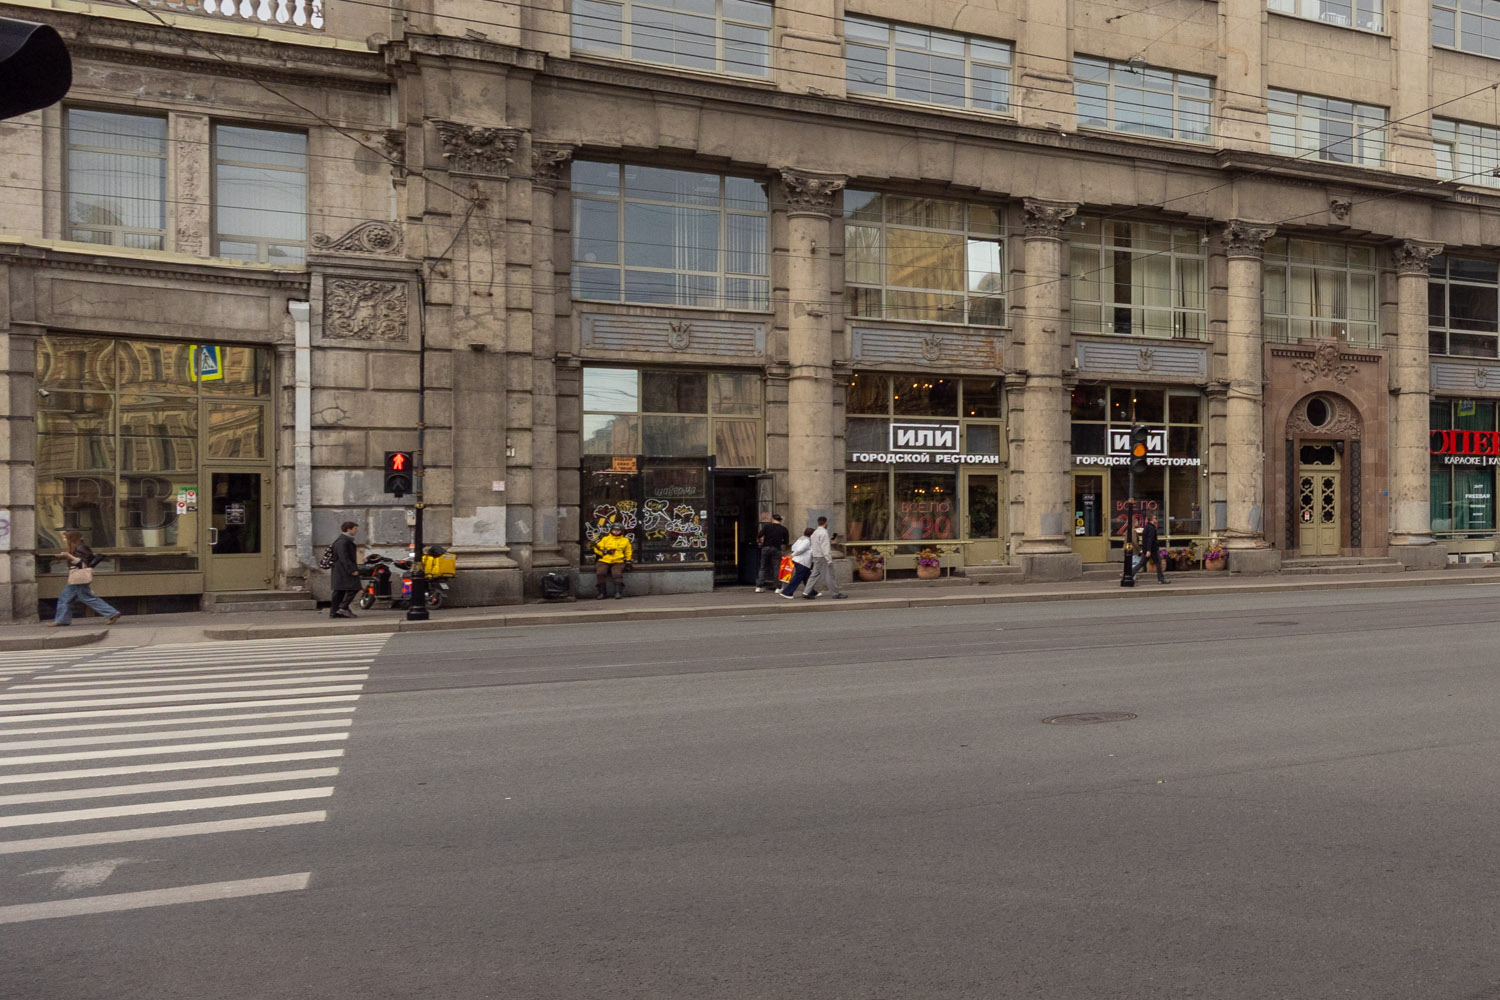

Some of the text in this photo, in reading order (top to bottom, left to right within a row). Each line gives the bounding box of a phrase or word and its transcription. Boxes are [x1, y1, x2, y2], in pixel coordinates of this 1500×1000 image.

[897, 428, 953, 447] ИЛИ
[1113, 434, 1162, 451] ИИ
[852, 452, 999, 464] ГОРОДСКОЙ РЕСТОРАН
[1076, 456, 1201, 466] ГОРОДСКО РЕСТОРАН
[1444, 456, 1481, 465] КАРАОКЕ
[900, 501, 950, 513] ВСЕ ПО
[1140, 500, 1159, 511] ПО
[900, 515, 951, 539] 290
